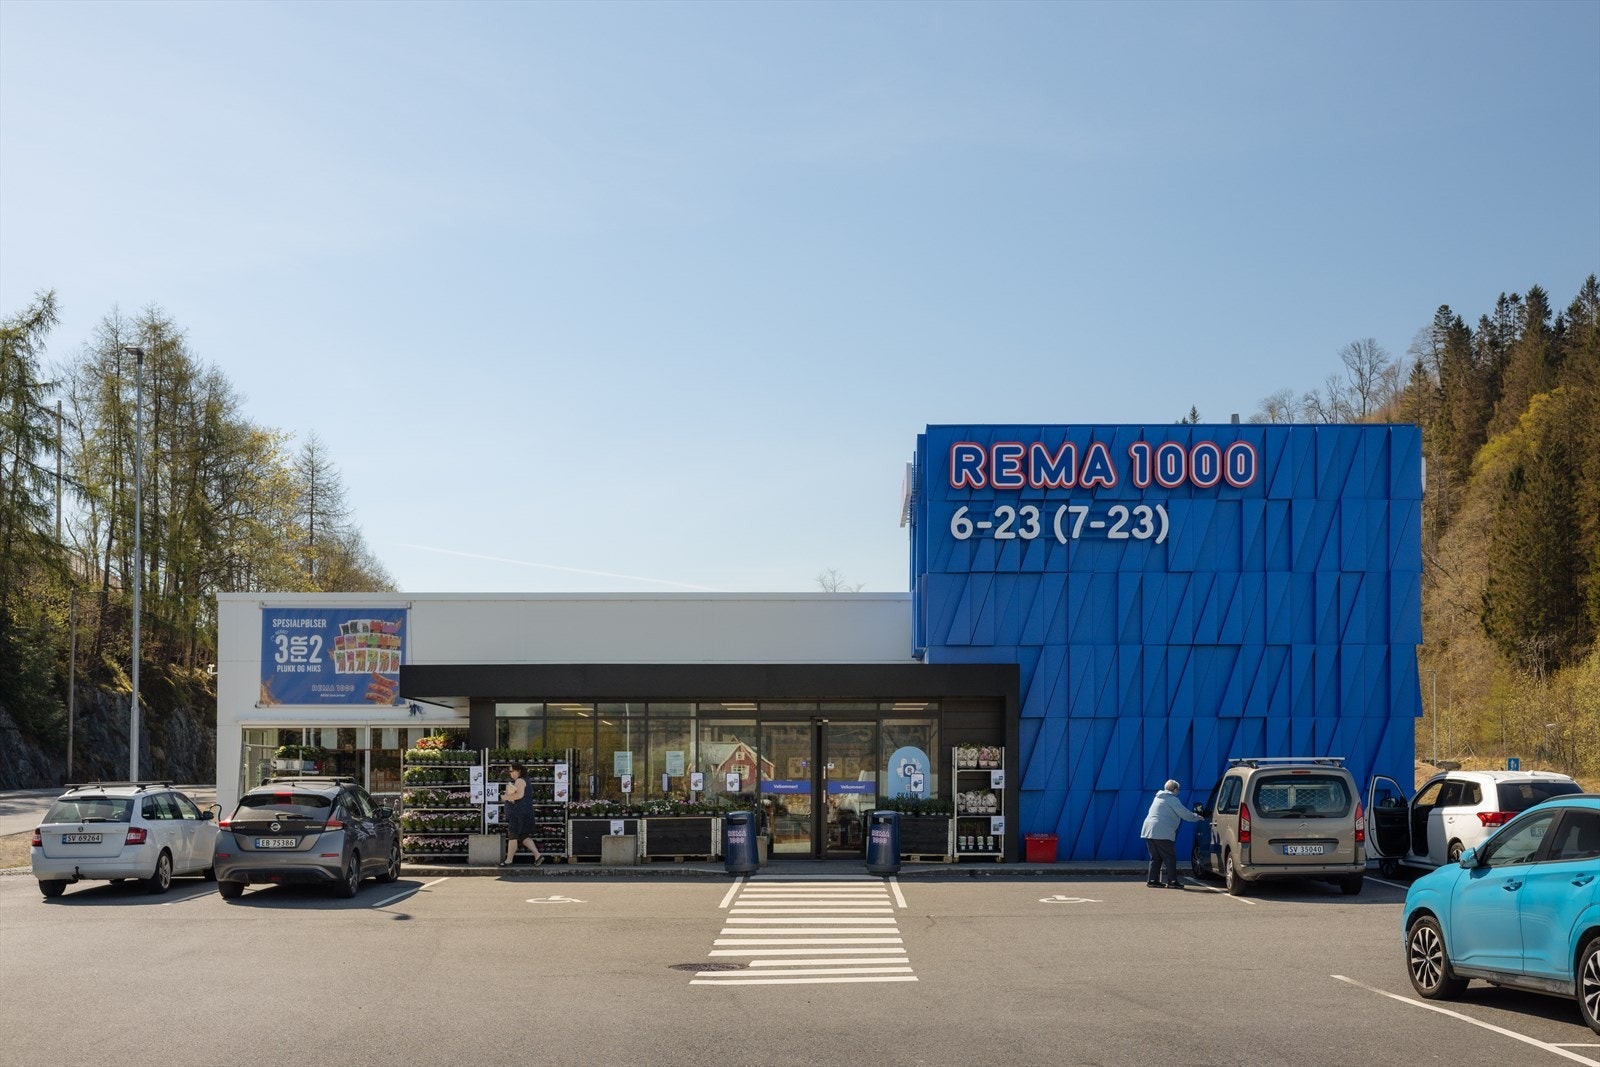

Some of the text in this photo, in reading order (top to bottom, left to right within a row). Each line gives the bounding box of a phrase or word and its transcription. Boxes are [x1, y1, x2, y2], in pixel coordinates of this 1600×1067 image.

[950, 440, 1258, 489] REMA 1000
[950, 503, 1170, 545] 6-23 (7-23)
[272, 618, 327, 628] SPESIALPØLSER
[274, 634, 323, 664] 3 FOR 2
[276, 664, 322, 673] PLUKK OG MIKS
[66, 834, 100, 842] SV 69264
[273, 839, 294, 847] 75386
